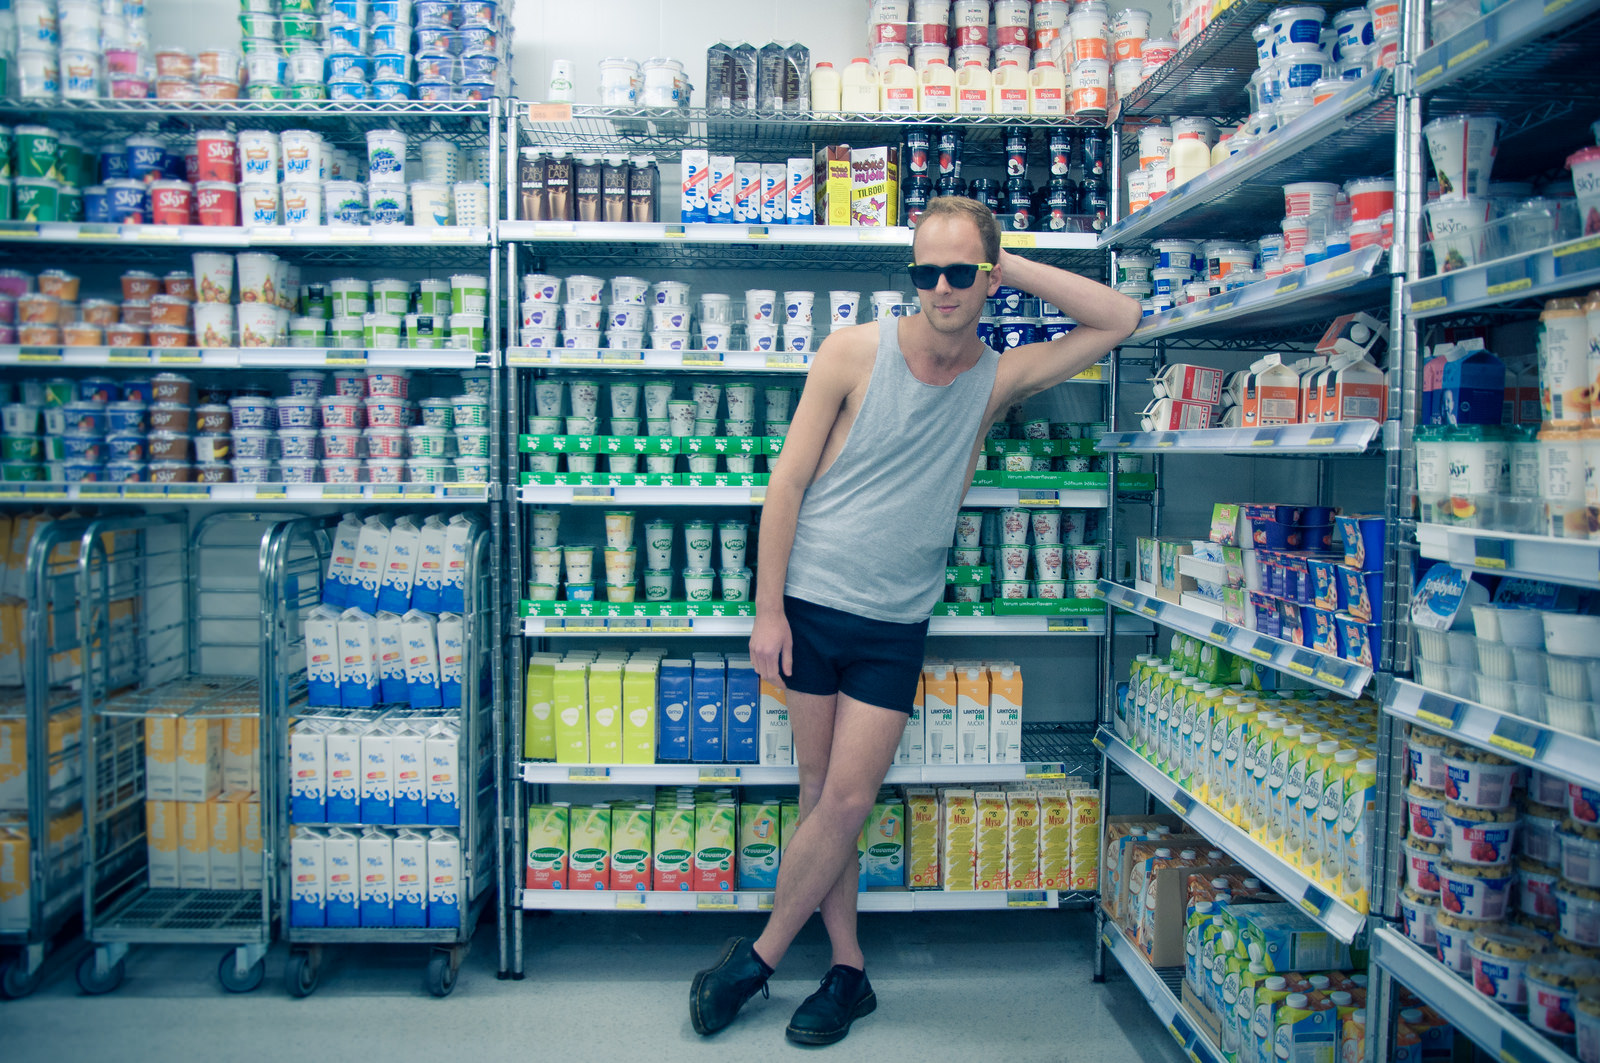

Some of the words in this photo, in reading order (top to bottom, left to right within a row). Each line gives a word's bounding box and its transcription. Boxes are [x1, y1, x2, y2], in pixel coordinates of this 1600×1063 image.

[966, 14, 985, 23] Rjómi
[1079, 76, 1099, 87] Rjómi
[208, 142, 235, 159] Skyr
[159, 191, 188, 208] Skyr
[916, 811, 932, 821] Mysa
[954, 814, 970, 825] Mysa
[1049, 815, 1065, 825] Mysa
[1080, 814, 1096, 825] Mysa
[985, 817, 1001, 828] Mysa
[1017, 817, 1033, 827] Mysa
